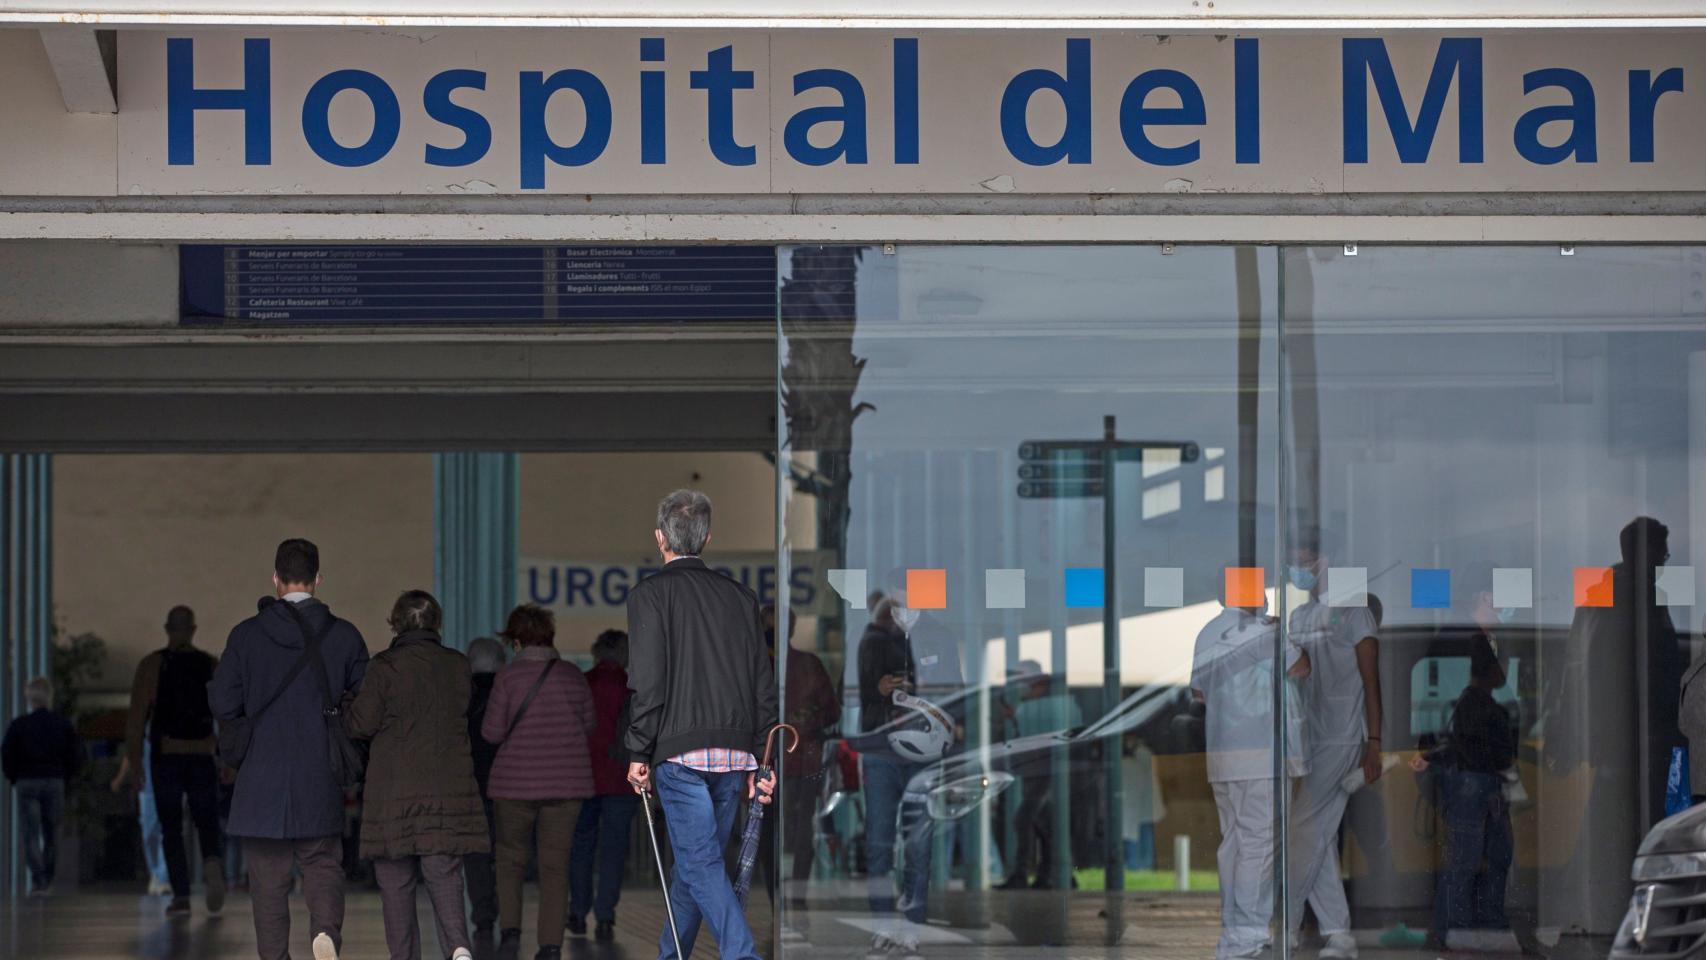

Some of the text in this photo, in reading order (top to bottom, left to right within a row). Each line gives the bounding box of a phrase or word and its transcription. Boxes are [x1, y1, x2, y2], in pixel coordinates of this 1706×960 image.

[168, 40, 1683, 189] Hospital del Mar
[249, 250, 276, 258] Menjar
[292, 250, 329, 258] emportar
[590, 248, 633, 256] Electrónica
[249, 262, 275, 270] Serveis
[276, 262, 309, 270] Funeraris
[567, 260, 602, 268] Llenceria
[249, 274, 275, 282] Serveis
[276, 274, 309, 282] Funeraris
[567, 272, 618, 280] Llaminadures
[249, 286, 275, 294] Serveis
[276, 286, 309, 294] Funeraris
[567, 285, 592, 293] Regals
[598, 284, 649, 293] complements
[249, 298, 285, 306] Cafeteria
[287, 298, 329, 306] Restaurant
[249, 311, 290, 319] Magatzem
